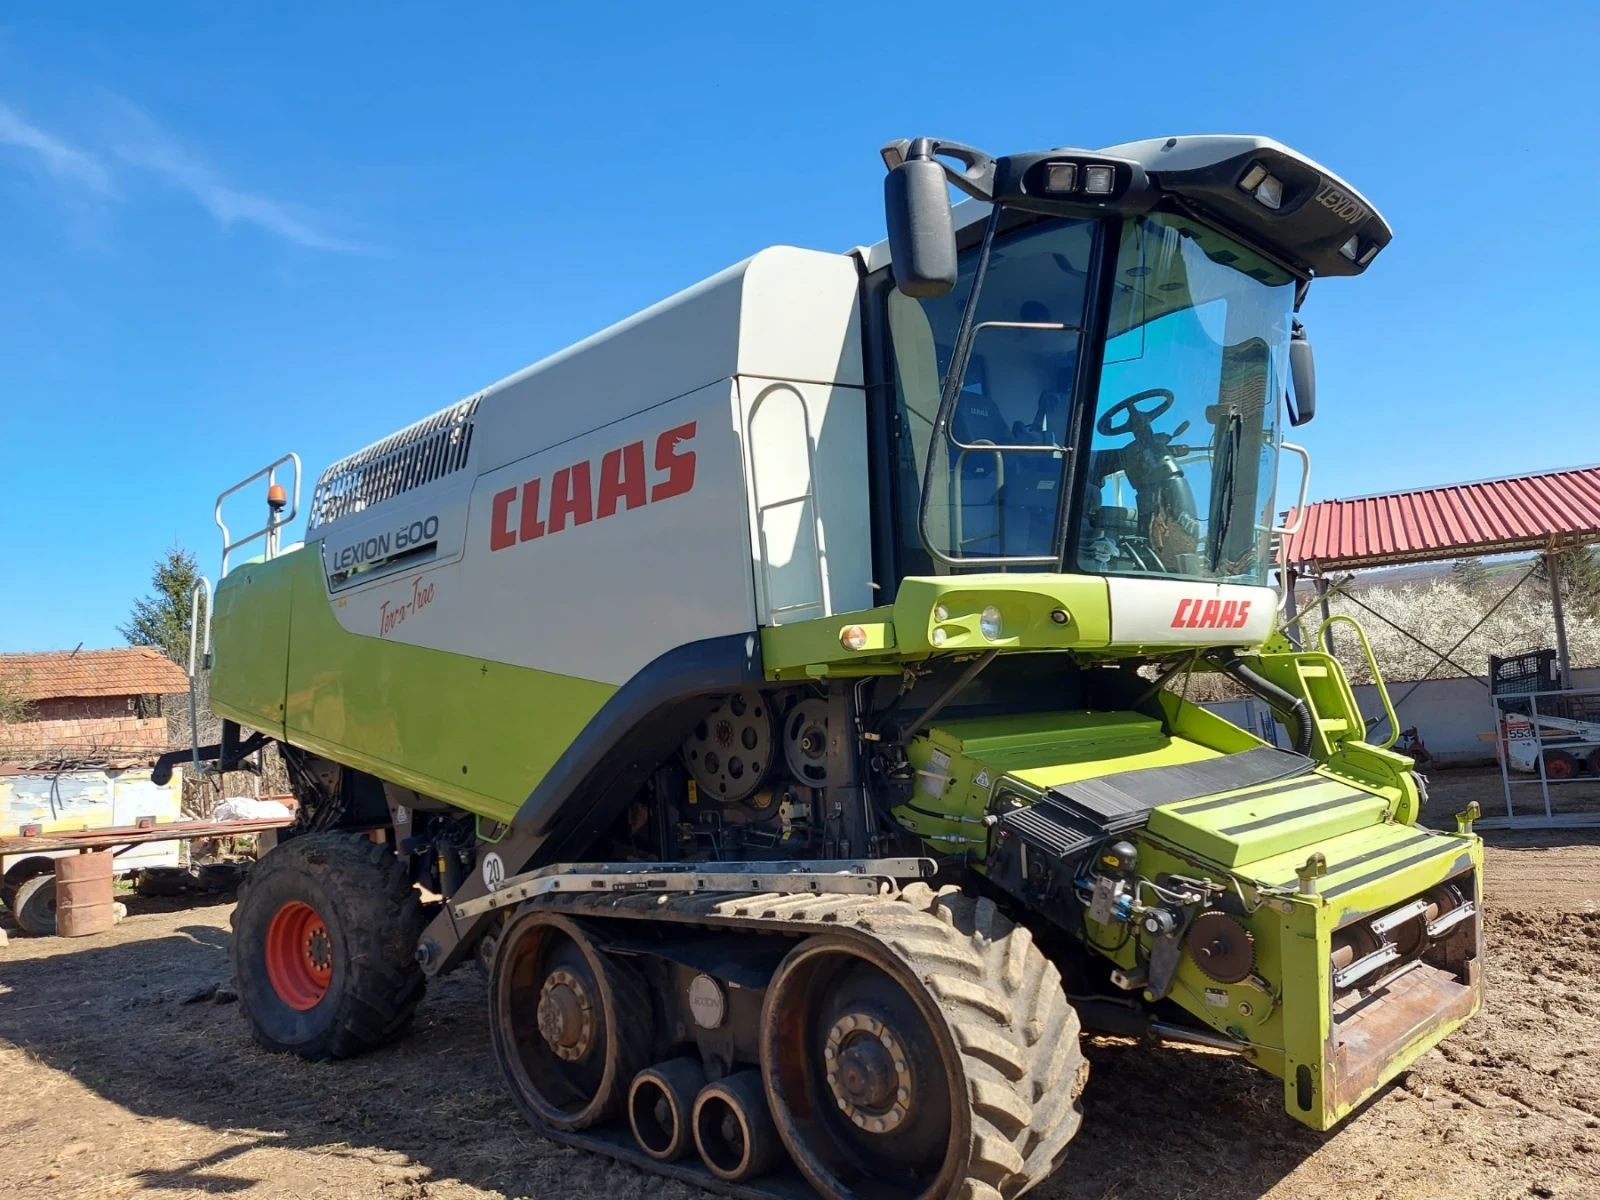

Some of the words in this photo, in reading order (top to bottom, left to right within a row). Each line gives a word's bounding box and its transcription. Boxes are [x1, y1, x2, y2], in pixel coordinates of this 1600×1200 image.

[1315, 185, 1367, 225] LEXION
[490, 421, 697, 552] CLAAS
[334, 532, 390, 571] LEXION
[395, 516, 439, 549] 600
[380, 576, 434, 637] Terra-Trac
[1170, 599, 1251, 628] CLAAS
[1509, 729, 1531, 739] 553
[486, 858, 500, 884] 20
